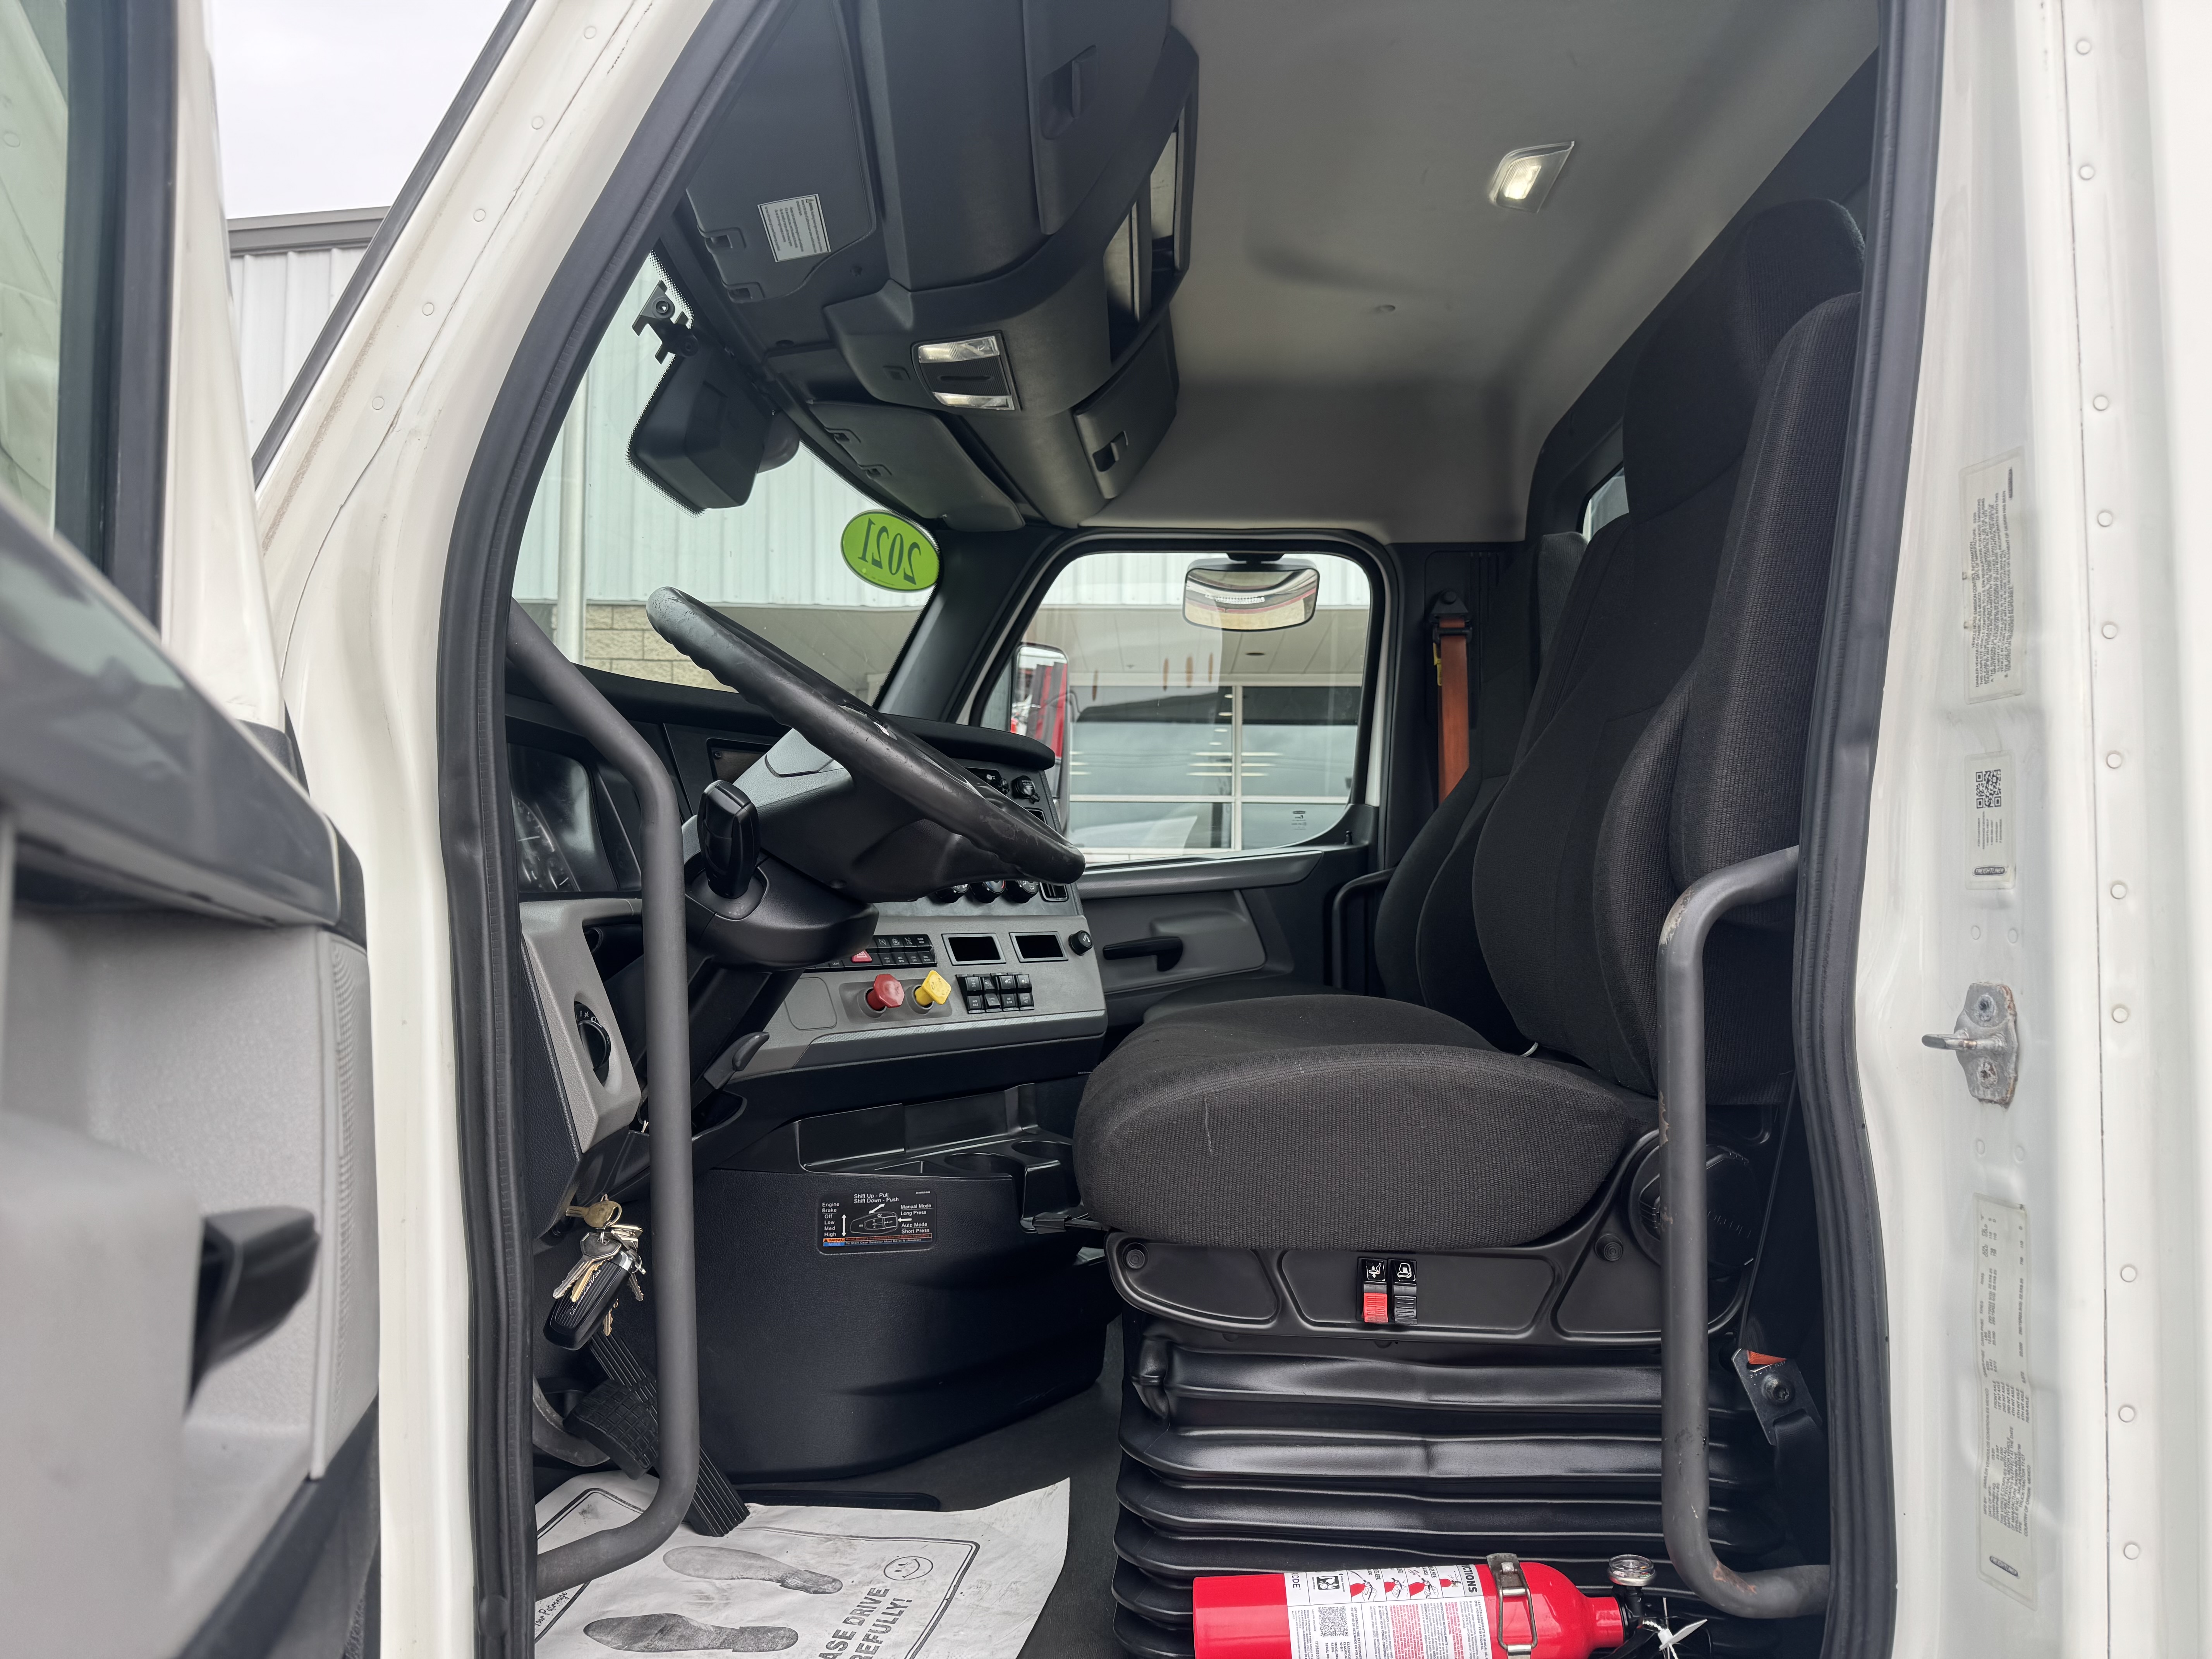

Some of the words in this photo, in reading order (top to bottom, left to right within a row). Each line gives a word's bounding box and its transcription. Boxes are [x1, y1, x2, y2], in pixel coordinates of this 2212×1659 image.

[538, 1592, 570, 1615] Patronage
[842, 1587, 890, 1626] DRIVE
[535, 1615, 545, 1626] our
